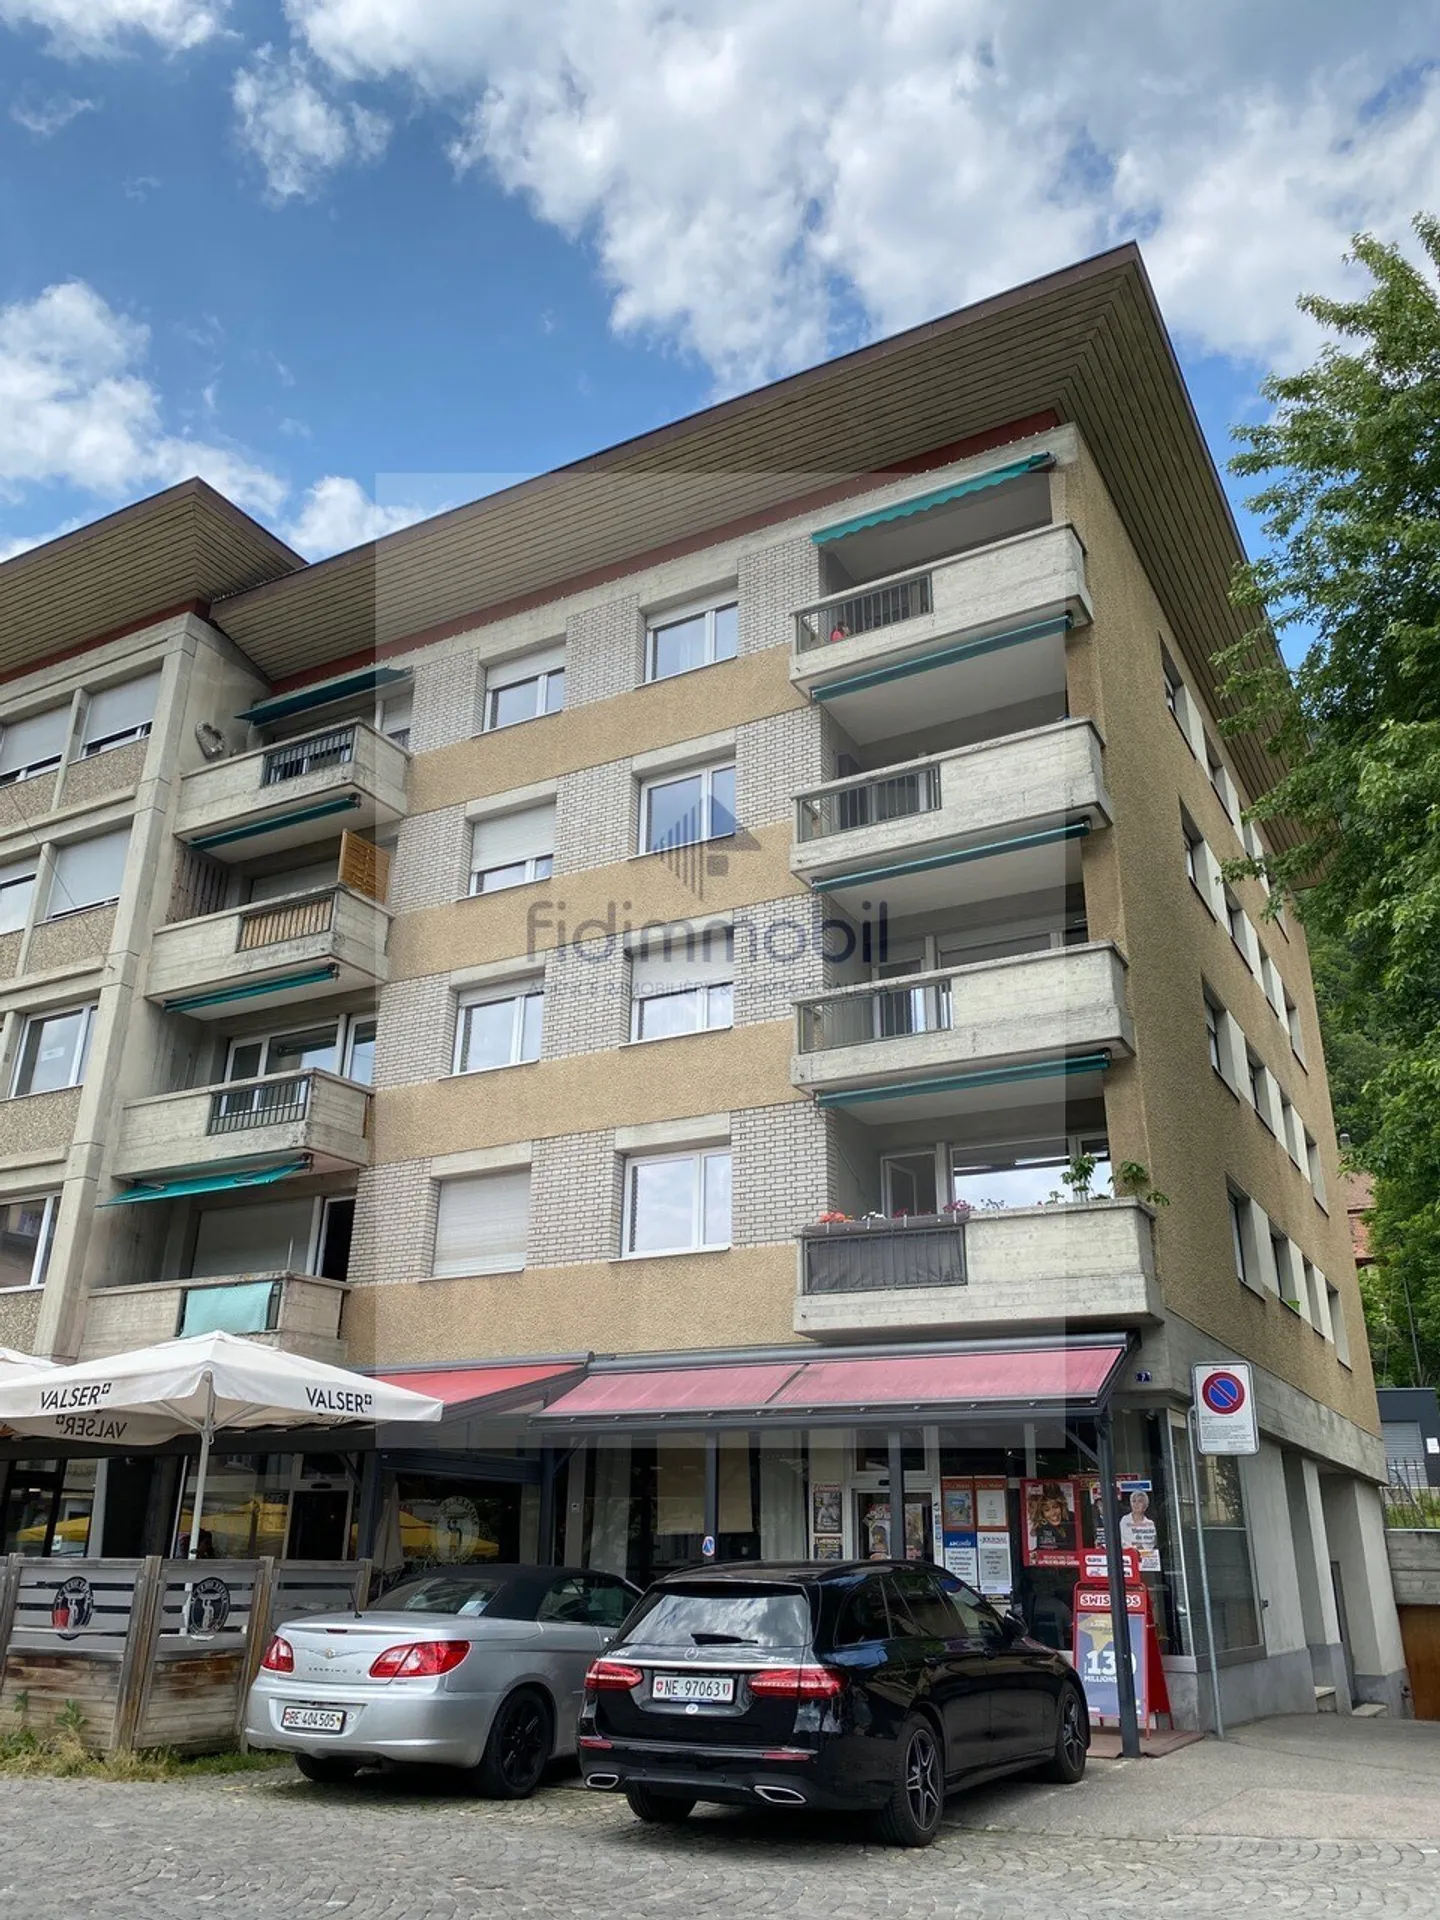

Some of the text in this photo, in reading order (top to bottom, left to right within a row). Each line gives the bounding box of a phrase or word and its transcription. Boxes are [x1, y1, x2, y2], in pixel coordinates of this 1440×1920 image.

[40, 1385, 101, 1410] VALSER
[305, 1386, 365, 1413] VALSER
[664, 1680, 721, 1697] NE 97063
